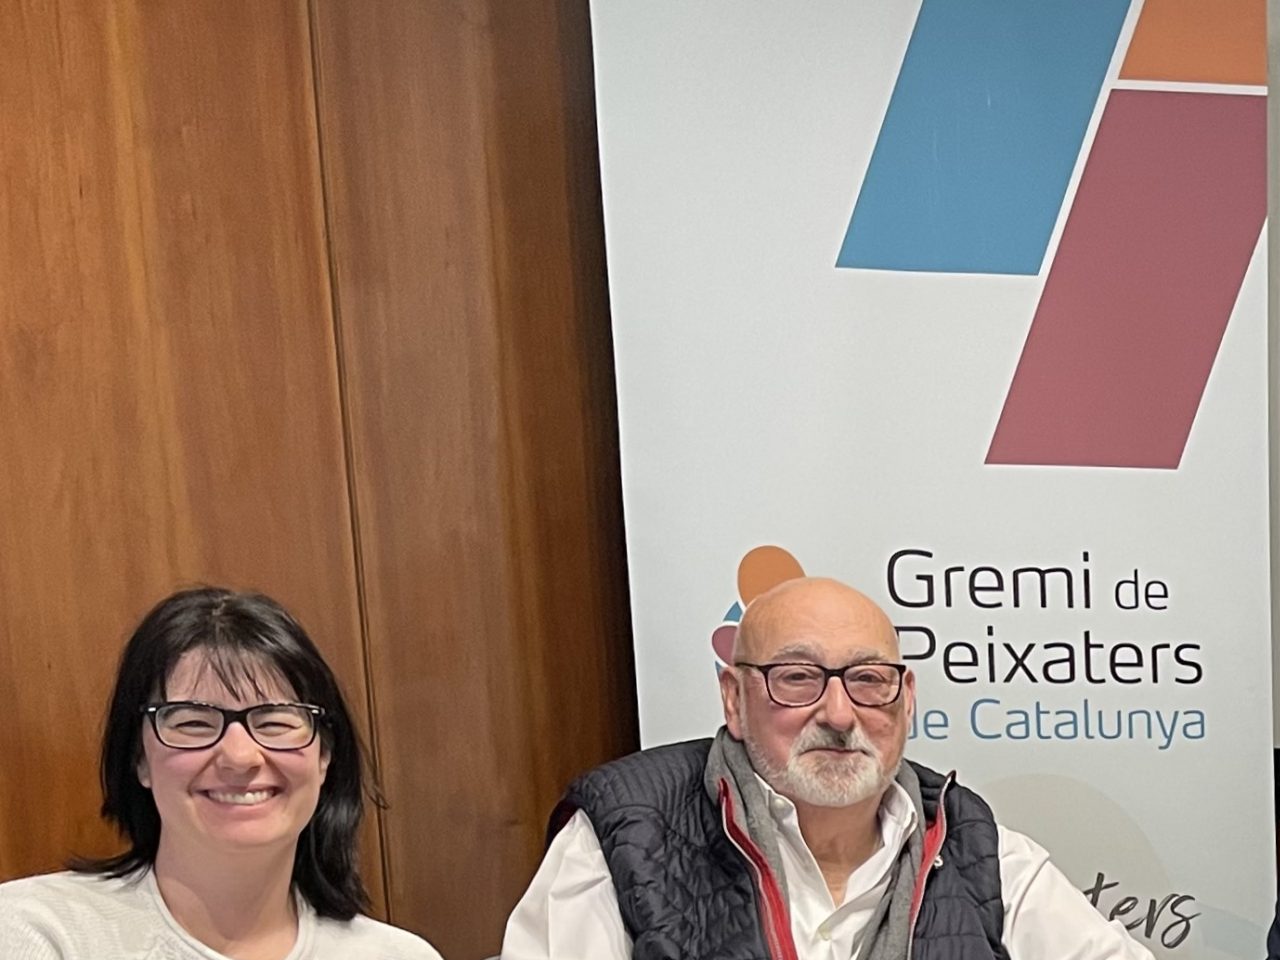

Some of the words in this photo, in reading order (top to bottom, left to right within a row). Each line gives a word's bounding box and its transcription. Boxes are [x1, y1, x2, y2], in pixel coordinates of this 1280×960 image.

[887, 549, 1091, 610] Gremi
[1115, 569, 1168, 610] de
[895, 625, 1203, 685] Peixaters
[970, 698, 1205, 749] Catalunya
[1083, 872, 1202, 949] ters
